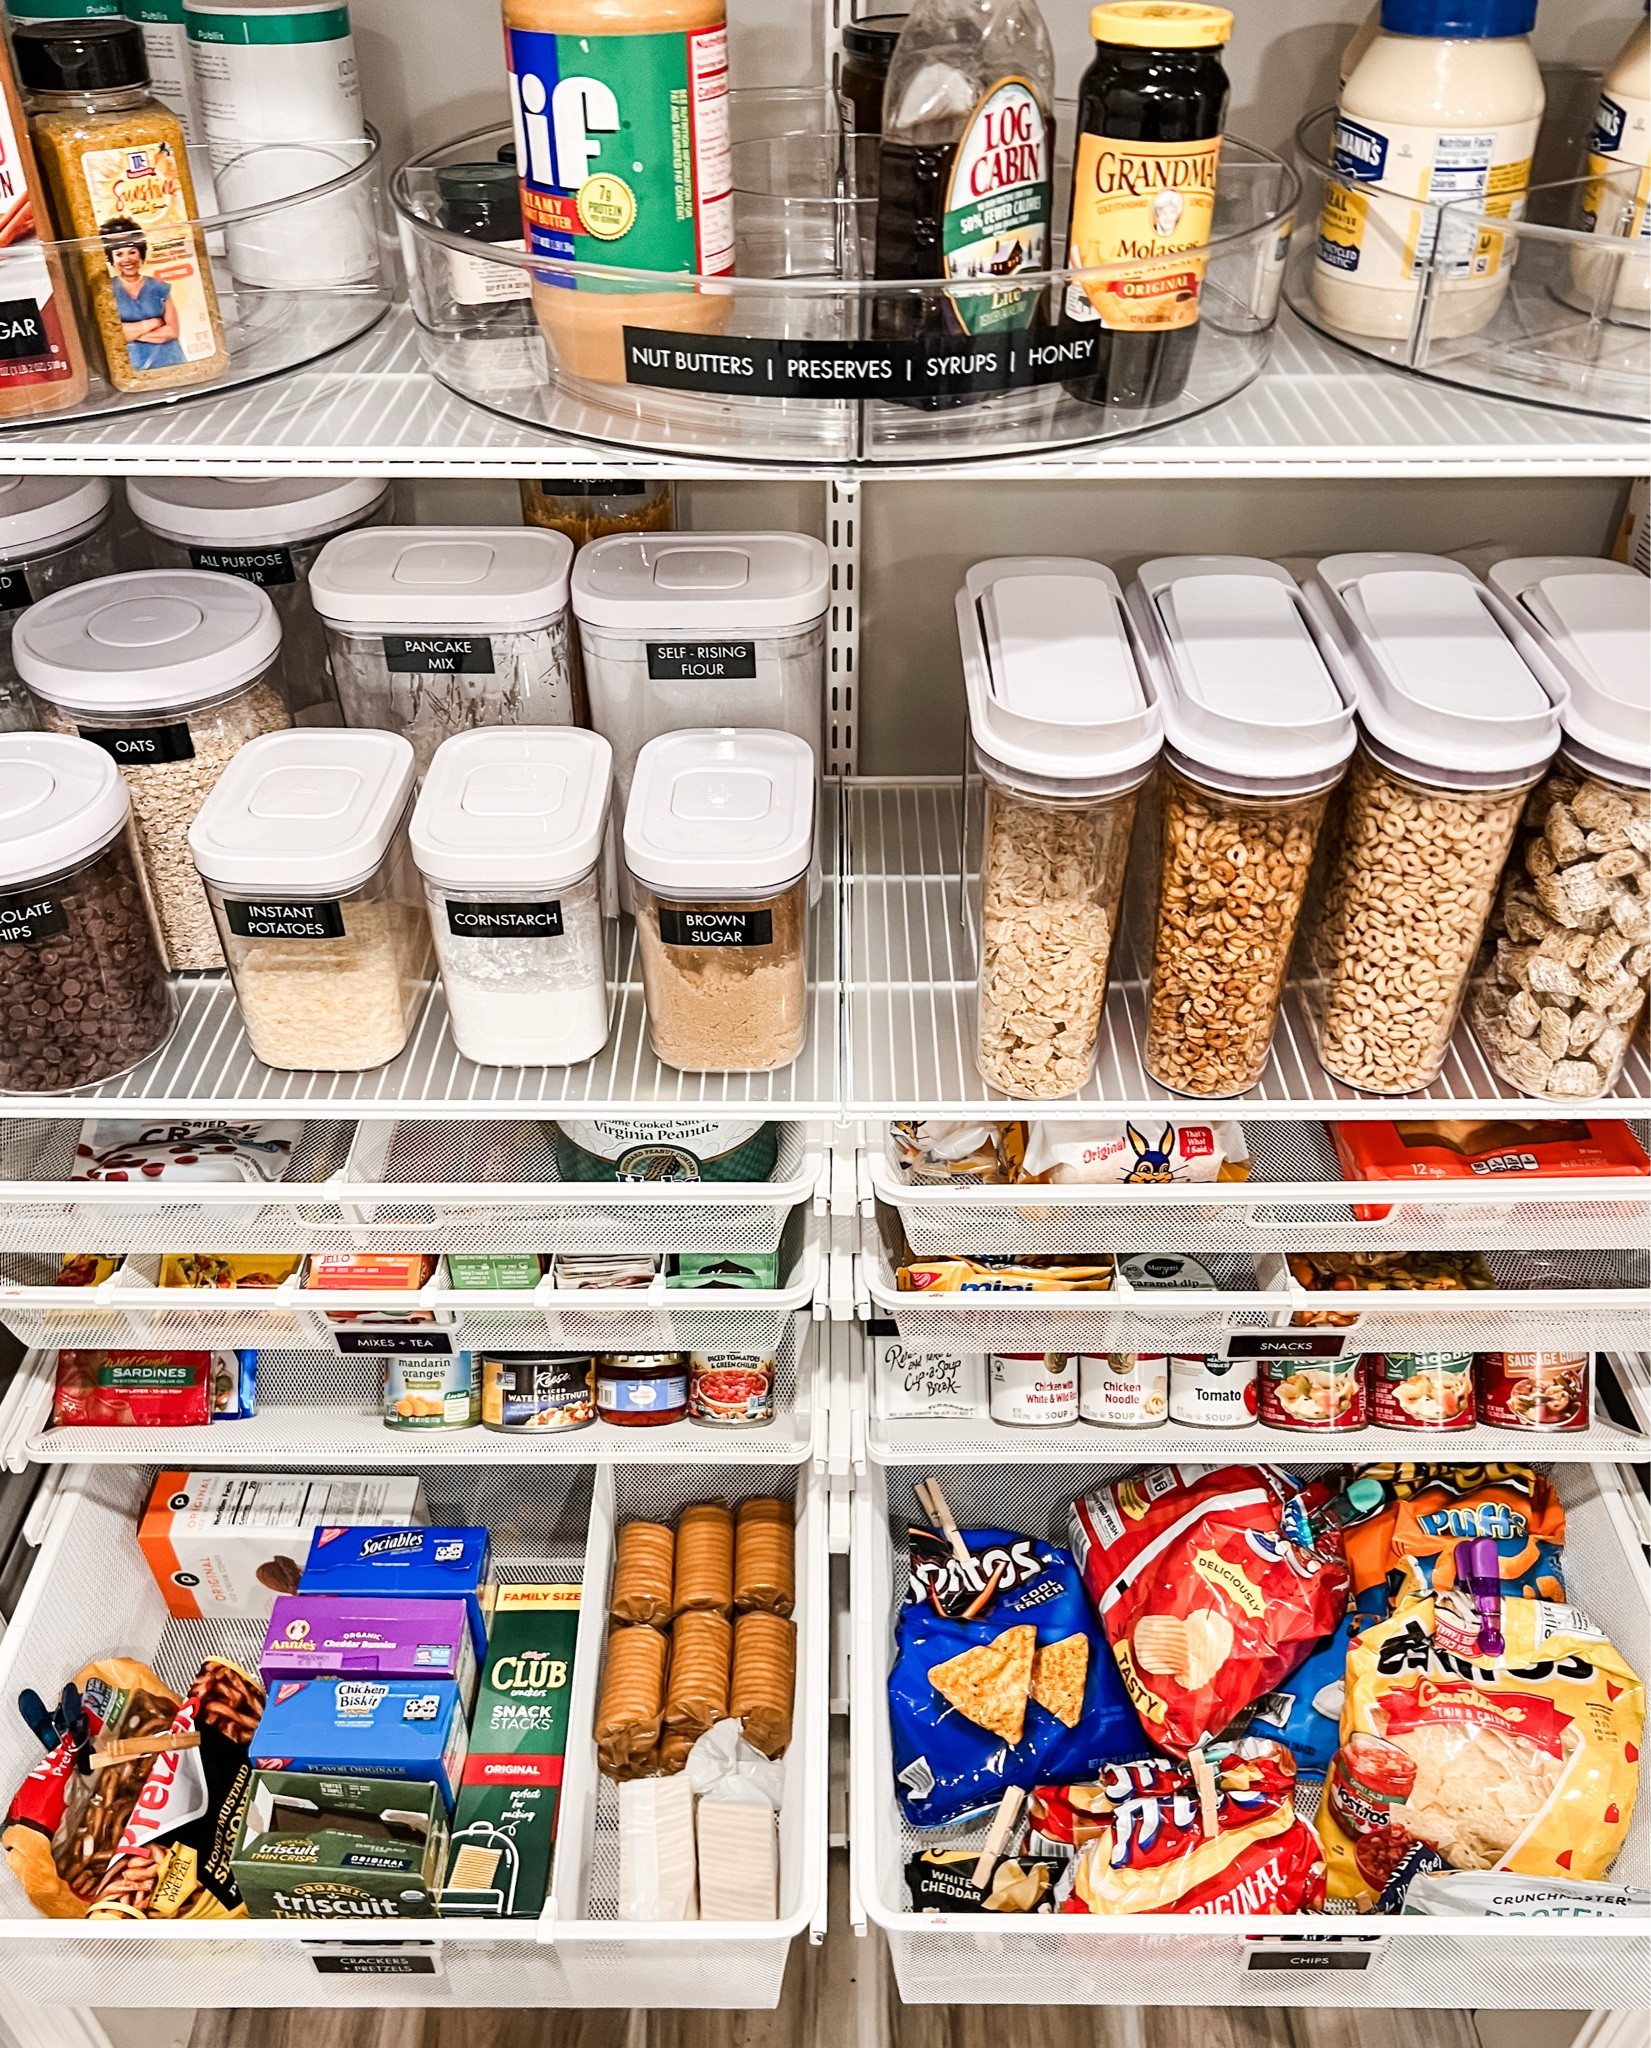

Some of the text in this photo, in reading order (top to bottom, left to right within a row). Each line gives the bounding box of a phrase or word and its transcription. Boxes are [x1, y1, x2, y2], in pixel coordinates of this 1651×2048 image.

[86, 5, 118, 14] Publix
[142, 11, 168, 21] Publix
[198, 30, 225, 41] Publix
[985, 103, 1033, 153] LOG
[970, 143, 1040, 197] CABIN
[588, 201, 623, 217] PROTEIN
[984, 203, 1014, 226] FEWER
[1123, 277, 1189, 297] ORIGINAL
[0, 318, 38, 340] GAR
[632, 338, 1096, 379] NUT BUTTERS PRESERVES SYRUPS HONEY
[199, 553, 283, 568] ALL PURPOSE
[405, 640, 473, 655] PANCAKE
[657, 646, 747, 660] SELF RISING
[428, 656, 456, 670] MIX
[681, 663, 725, 677] FLOUR
[115, 740, 155, 754] OATS
[248, 905, 314, 920] INSTANT
[454, 912, 558, 927] CORNSTARCH
[685, 914, 746, 927] BROWN
[247, 921, 324, 936] POTATOES
[691, 930, 743, 943] SUGAR
[181, 1119, 228, 1128] DRIED
[594, 1120, 720, 1141] Virginia Peanuts
[1185, 1130, 1206, 1138] That's
[1187, 1138, 1206, 1146] What
[645, 1149, 675, 1157] PEANUT
[1082, 1136, 1127, 1164] Original
[1411, 1163, 1428, 1176] 12
[1147, 1263, 1180, 1273] Marzetti
[1131, 1278, 1200, 1291] caramel dip
[357, 1339, 395, 1347] MIXES
[411, 1339, 434, 1347] TEA
[1260, 1342, 1313, 1350] SNACKS
[399, 1358, 451, 1368] mandarin
[707, 1354, 761, 1363] DICED TOMATOES
[1507, 1353, 1558, 1367] SAUSAGE
[112, 1367, 187, 1378] SARDINES
[402, 1369, 446, 1380] oranges
[535, 1372, 571, 1388] Reese
[1035, 1381, 1061, 1392] Chicken
[1103, 1381, 1141, 1392] Chicken
[541, 1390, 589, 1402] CHESTNUTS
[1026, 1393, 1049, 1404] White
[1056, 1391, 1069, 1402] Wild
[1105, 1393, 1140, 1404] Noodle
[1195, 1388, 1242, 1402] Tomato
[1045, 1410, 1068, 1420] SOUP
[1109, 1411, 1135, 1420] SOUP
[1205, 1412, 1233, 1422] SOUP
[188, 1477, 212, 1529] ORIGINAL
[1104, 1513, 1119, 1537] FRESH
[360, 1532, 424, 1557] Sociables
[200, 1557, 226, 1601] ORIGINAL
[1198, 1557, 1261, 1613] DELICIOUSLY
[504, 1592, 582, 1602] FAMILY SIZE
[1014, 1584, 1065, 1612] RANCH
[1020, 1580, 1057, 1603] COOL
[343, 1631, 382, 1641] ORGANIC
[270, 1638, 317, 1651] Annie's
[323, 1639, 361, 1649] Cheddar
[491, 1655, 568, 1690] CLUB
[338, 1684, 387, 1696] Chicken
[1117, 1653, 1159, 1715] TASTY
[340, 1695, 379, 1708] Biskit
[492, 1705, 552, 1719] SNACK
[1436, 1706, 1462, 1719] THIN
[490, 1718, 553, 1731] STACKS
[307, 1764, 406, 1774] FLAVOR ORIGINALS
[484, 1764, 541, 1775] ORIGINAL
[204, 1764, 250, 1872] HONEY MUSTARD
[259, 1842, 320, 1856] triscuit
[251, 1853, 318, 1864] THIN CRISPS
[350, 1855, 404, 1867] ORIGINAL
[167, 1857, 193, 1903] PRETZEL
[931, 1869, 973, 1889] WHITE
[293, 1882, 371, 1899] ORGANIC
[921, 1880, 981, 1901] CHEDDAR
[273, 1891, 399, 1916] triscuit
[340, 1957, 409, 1965] CRACKERS
[1290, 1957, 1330, 1965] CHIPS
[354, 1965, 413, 1973] PRETZELS
